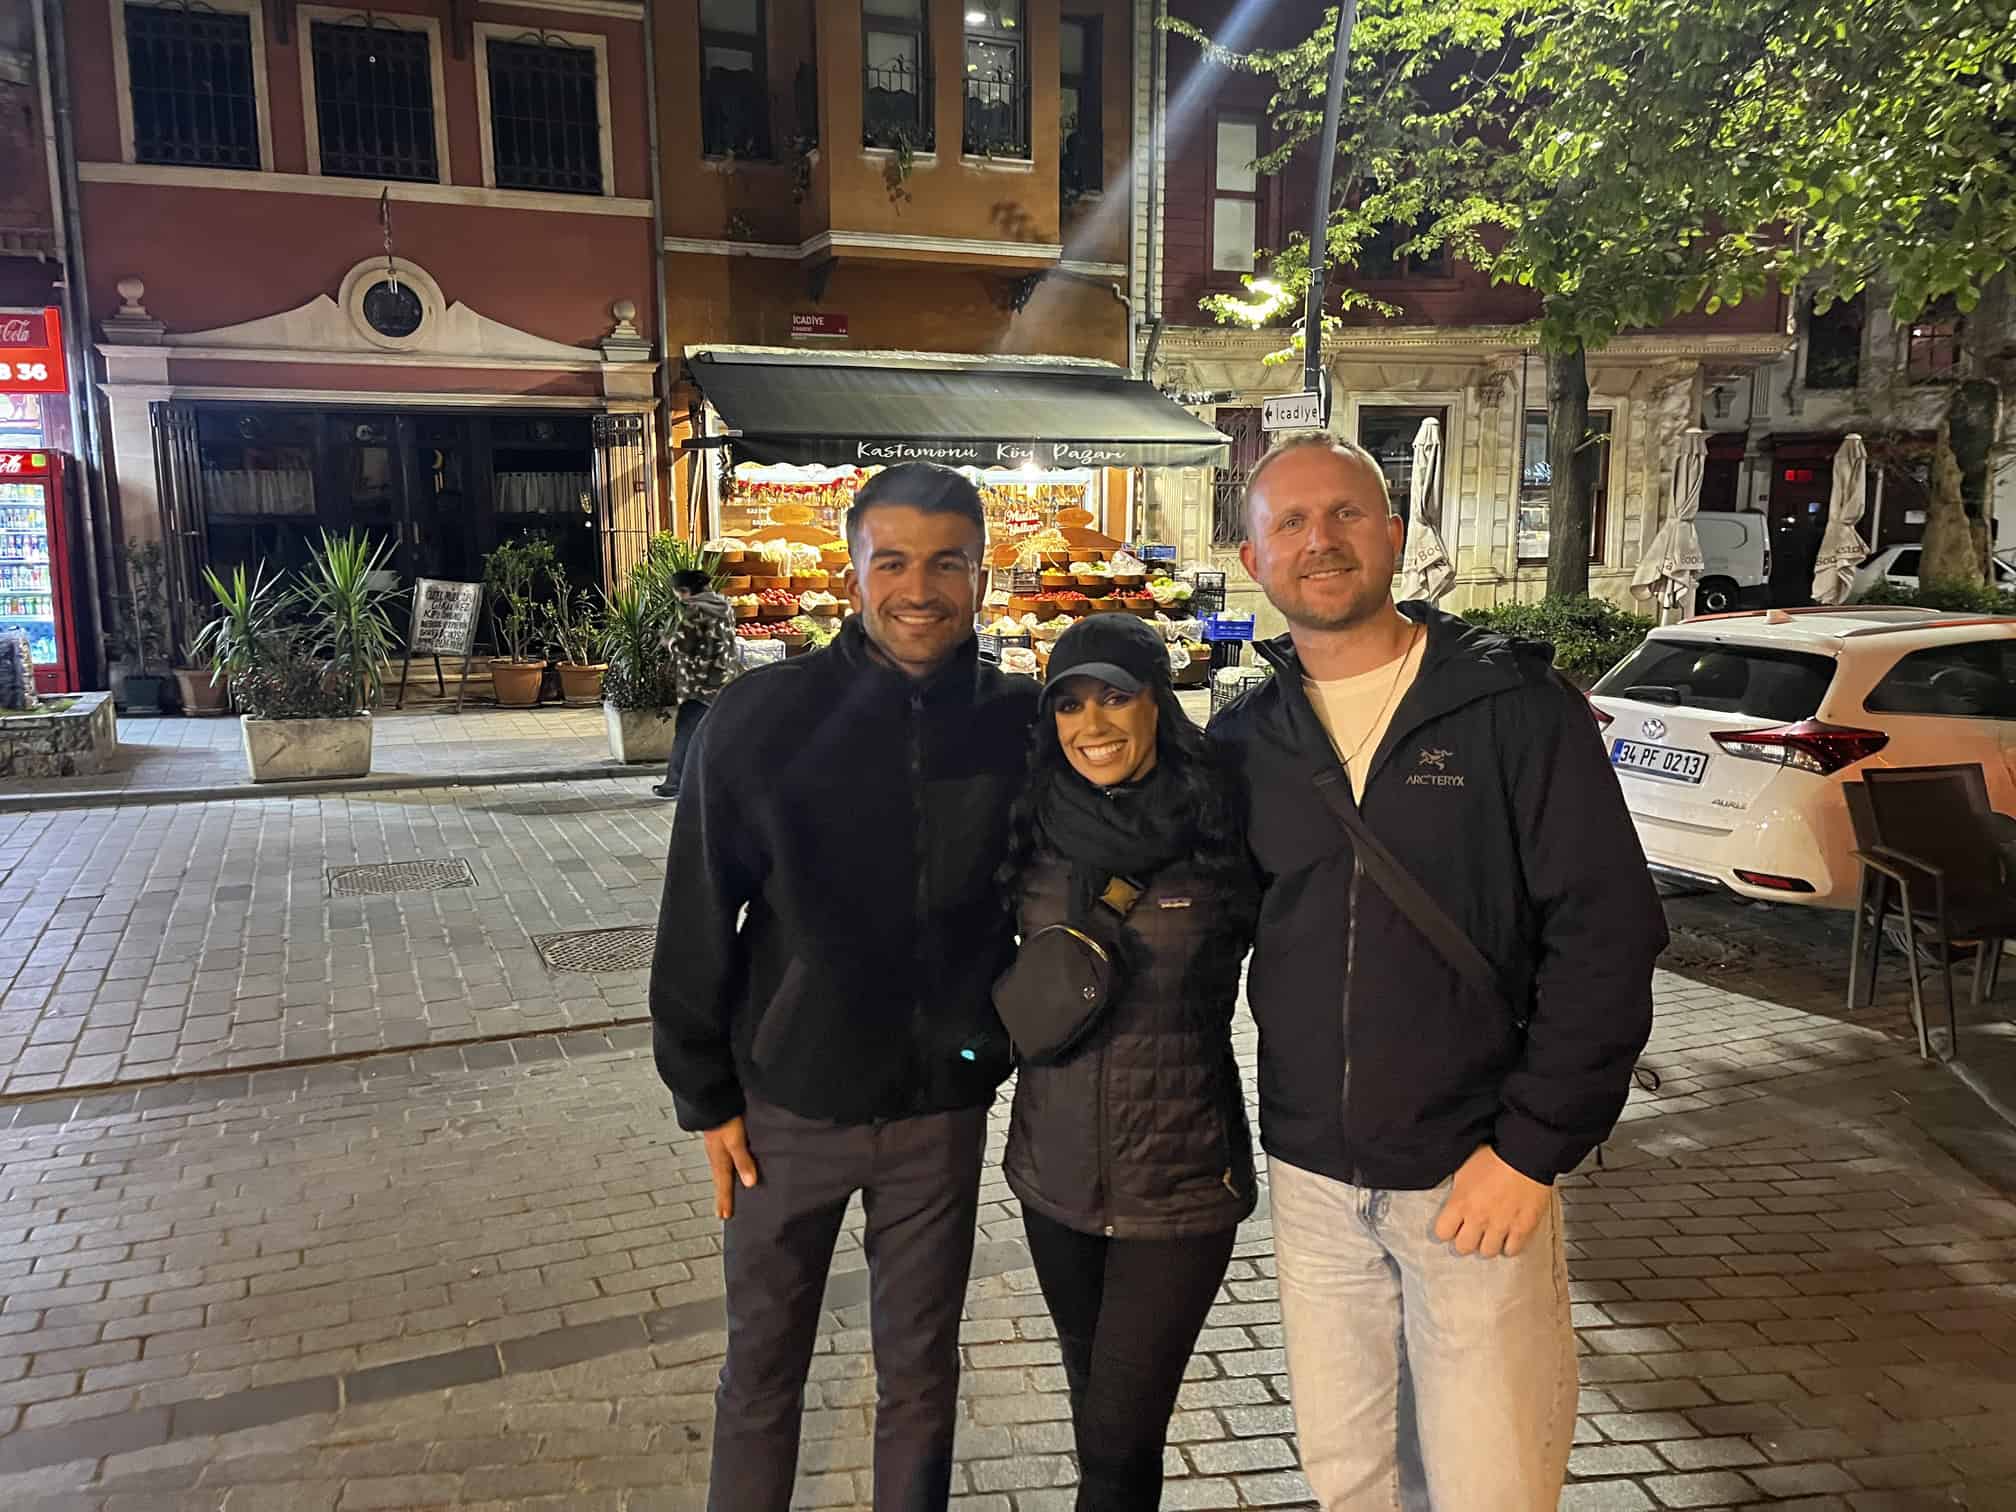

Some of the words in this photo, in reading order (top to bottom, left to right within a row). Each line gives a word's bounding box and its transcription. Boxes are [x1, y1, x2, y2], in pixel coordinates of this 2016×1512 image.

[792, 314, 825, 326] İCADİYE
[857, 441, 978, 459] Kastamonu
[1053, 443, 1126, 464] Pazarı
[1620, 745, 1636, 763] 34
[1640, 748, 1659, 766] PF
[1663, 752, 1699, 775] 0213
